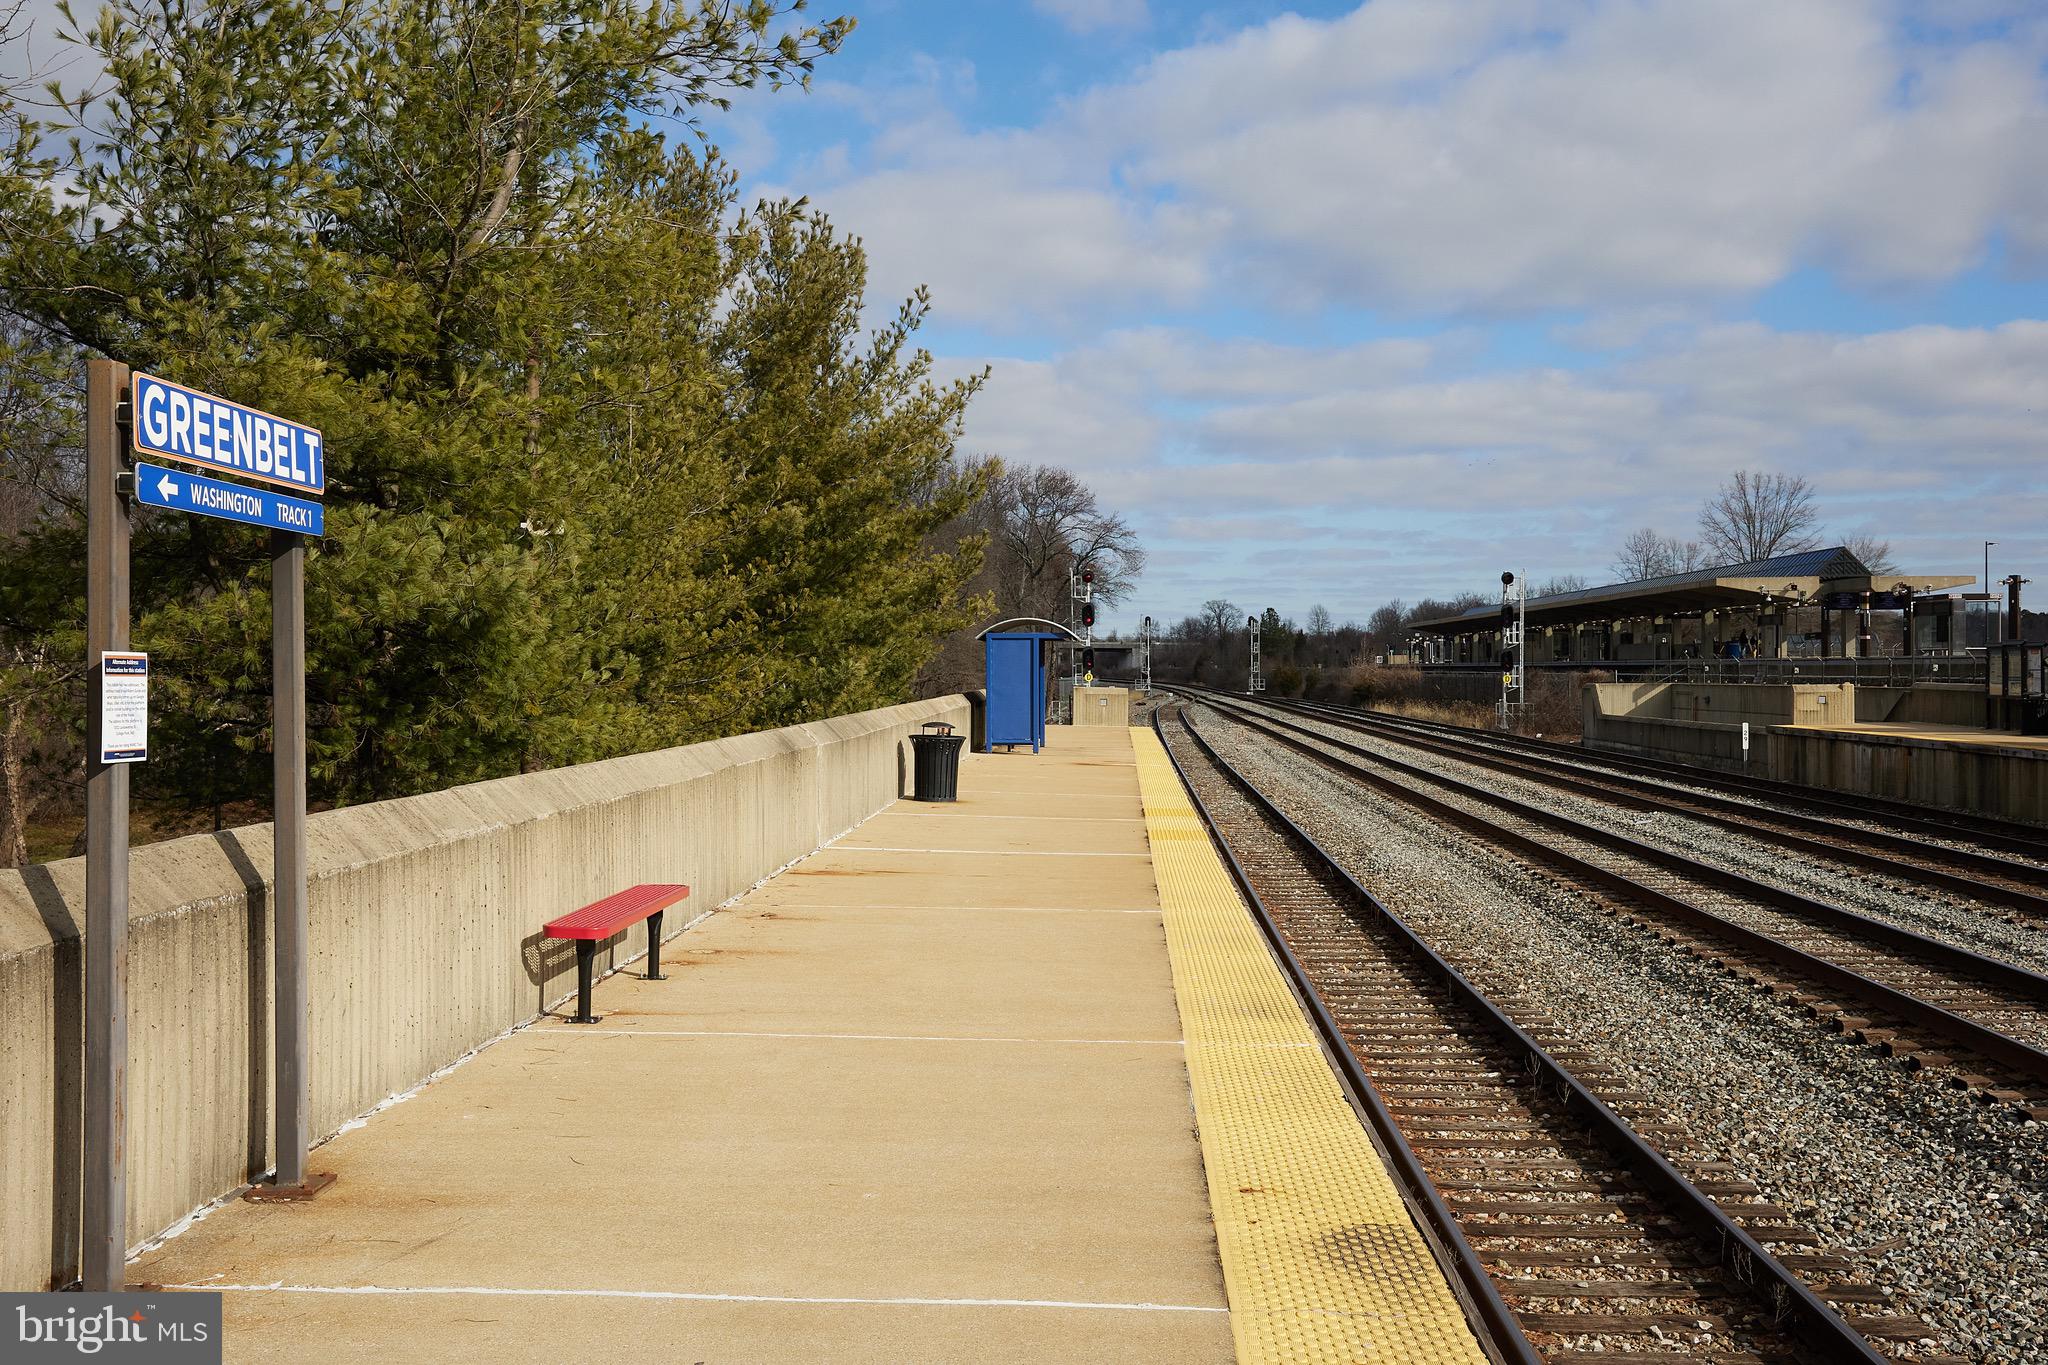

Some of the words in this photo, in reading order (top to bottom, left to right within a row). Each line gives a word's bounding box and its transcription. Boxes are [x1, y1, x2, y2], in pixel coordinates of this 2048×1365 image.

[142, 384, 319, 485] GREENBELT
[190, 482, 262, 517] WASHINGTON
[276, 502, 306, 527] TRACK
[307, 510, 313, 528] 1
